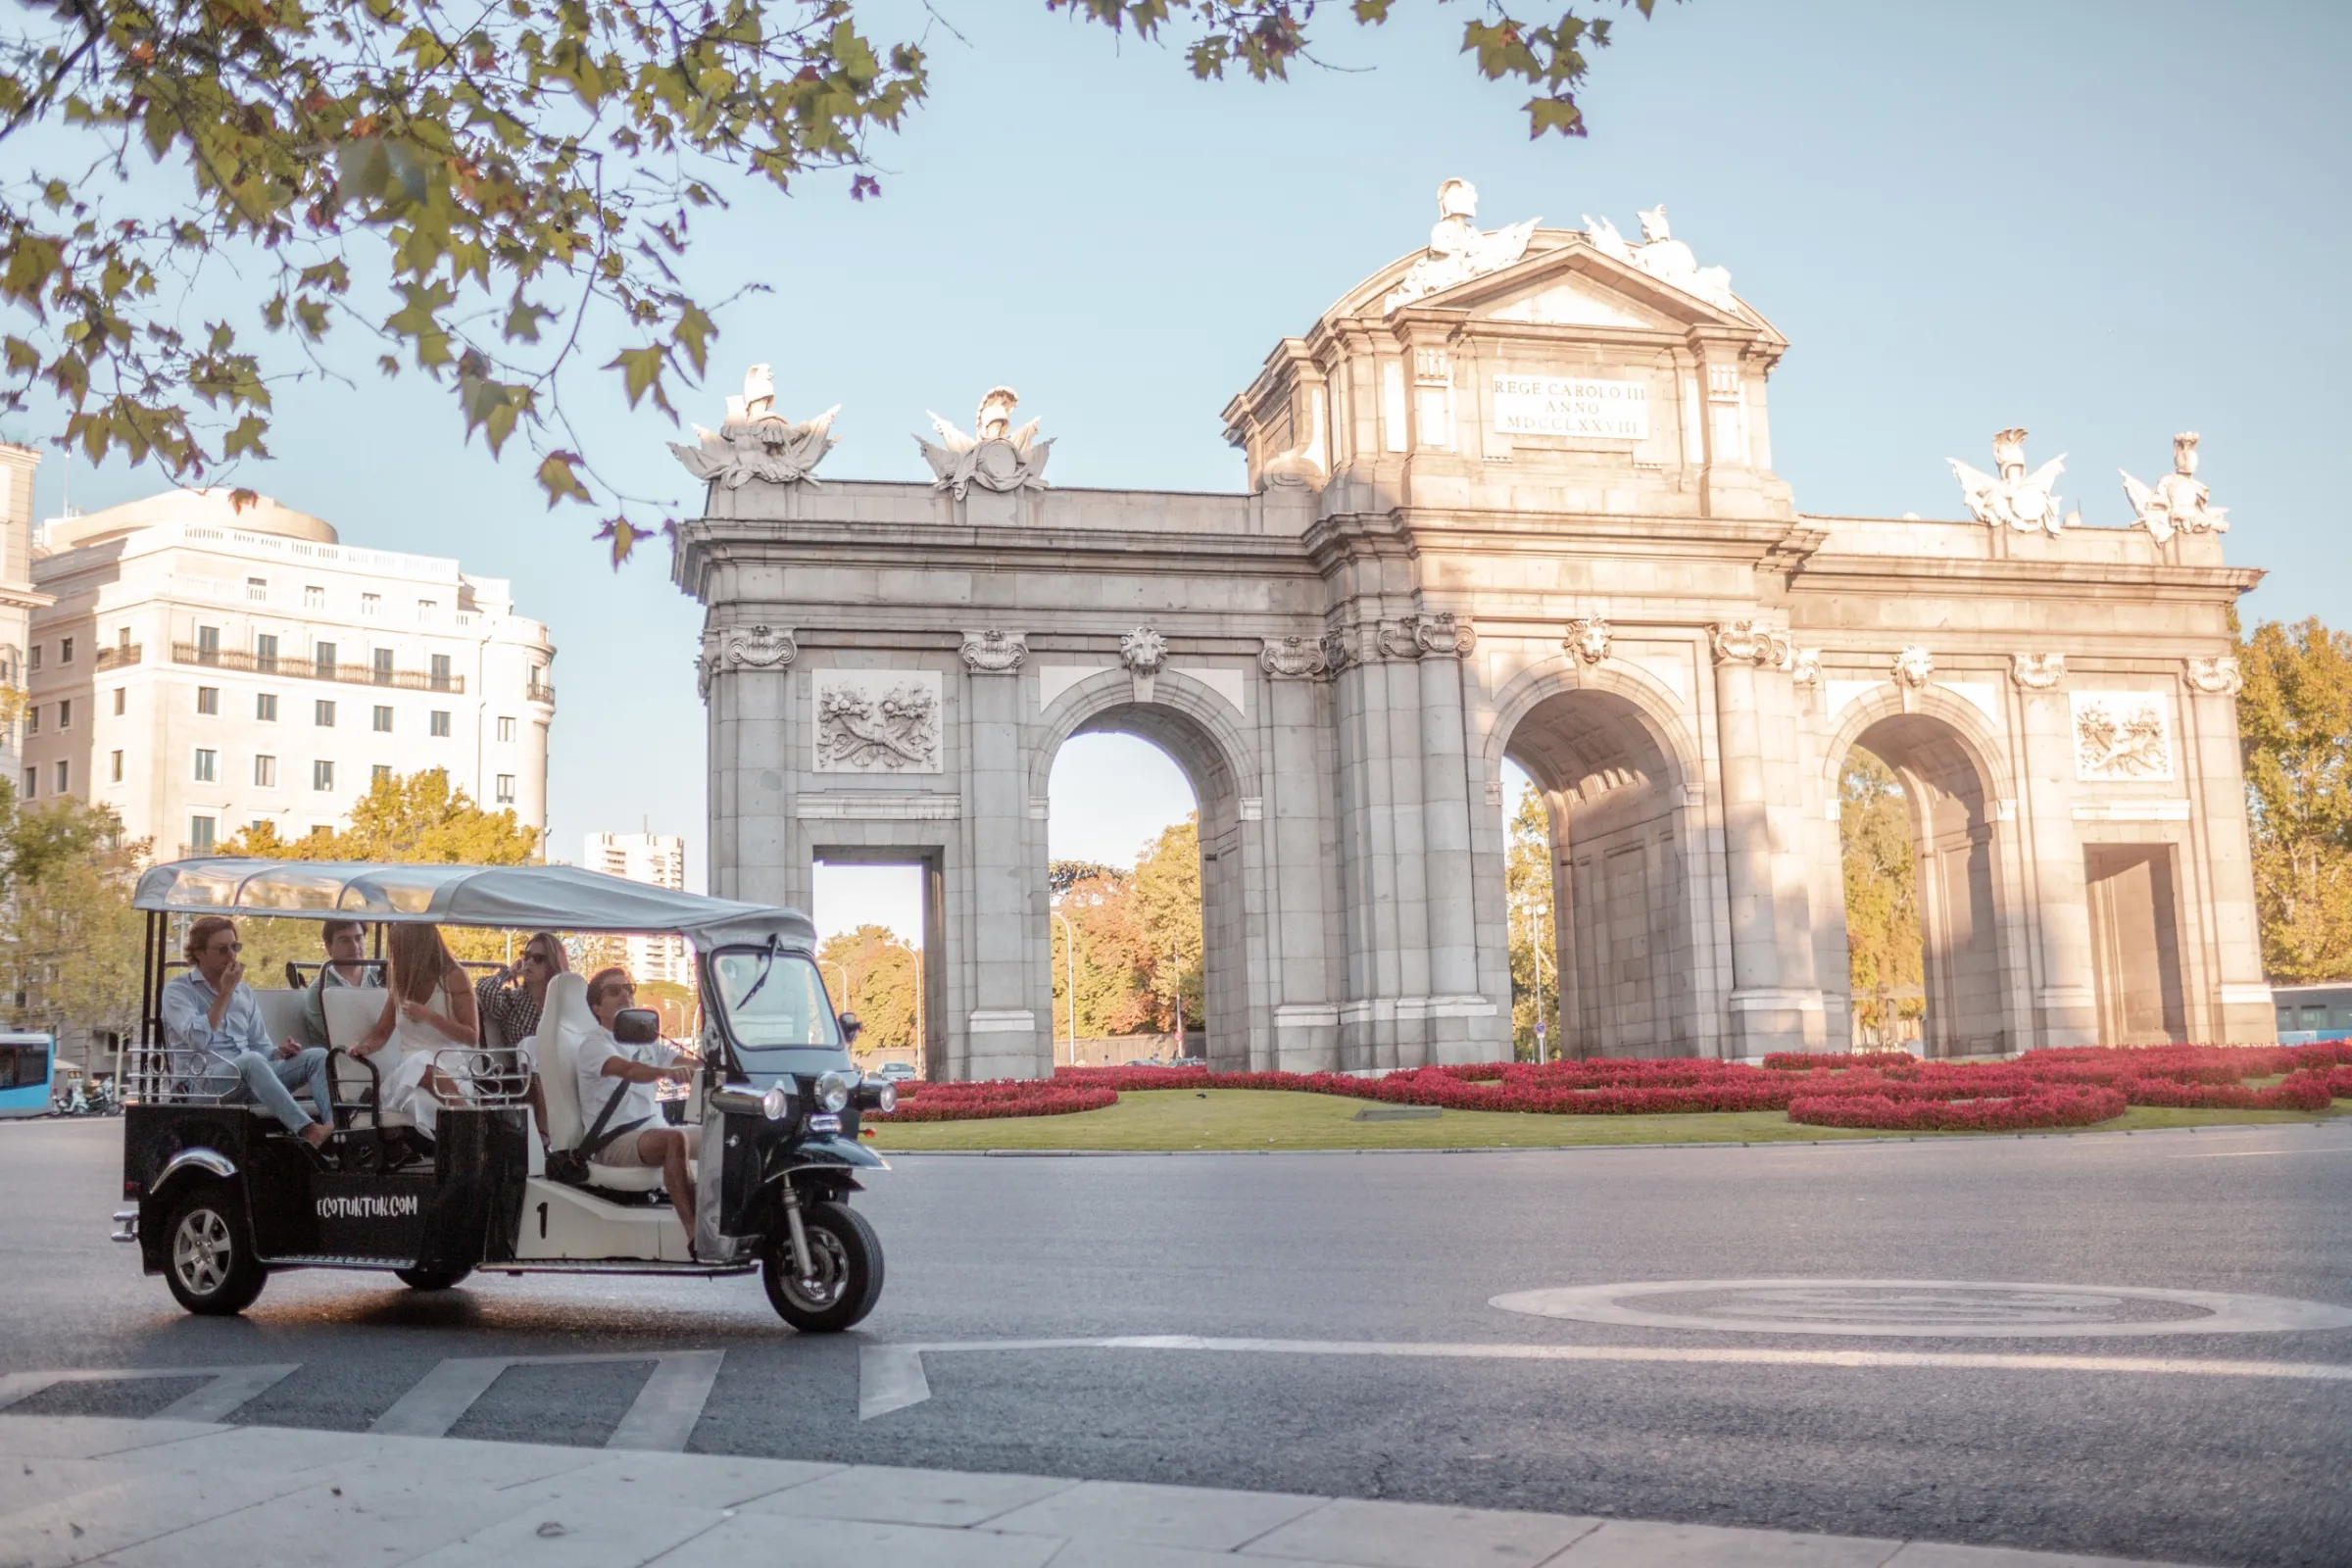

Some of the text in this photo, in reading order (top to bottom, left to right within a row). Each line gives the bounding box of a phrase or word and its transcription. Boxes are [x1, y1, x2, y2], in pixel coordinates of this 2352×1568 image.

[1494, 381, 1645, 400] REGE CAROLO III
[1545, 401, 1598, 414] ANNO
[1507, 416, 1637, 434] MDCCLXXVIII
[317, 1195, 417, 1218] ECOTUKTUK.COM
[536, 1201, 549, 1239] 1
